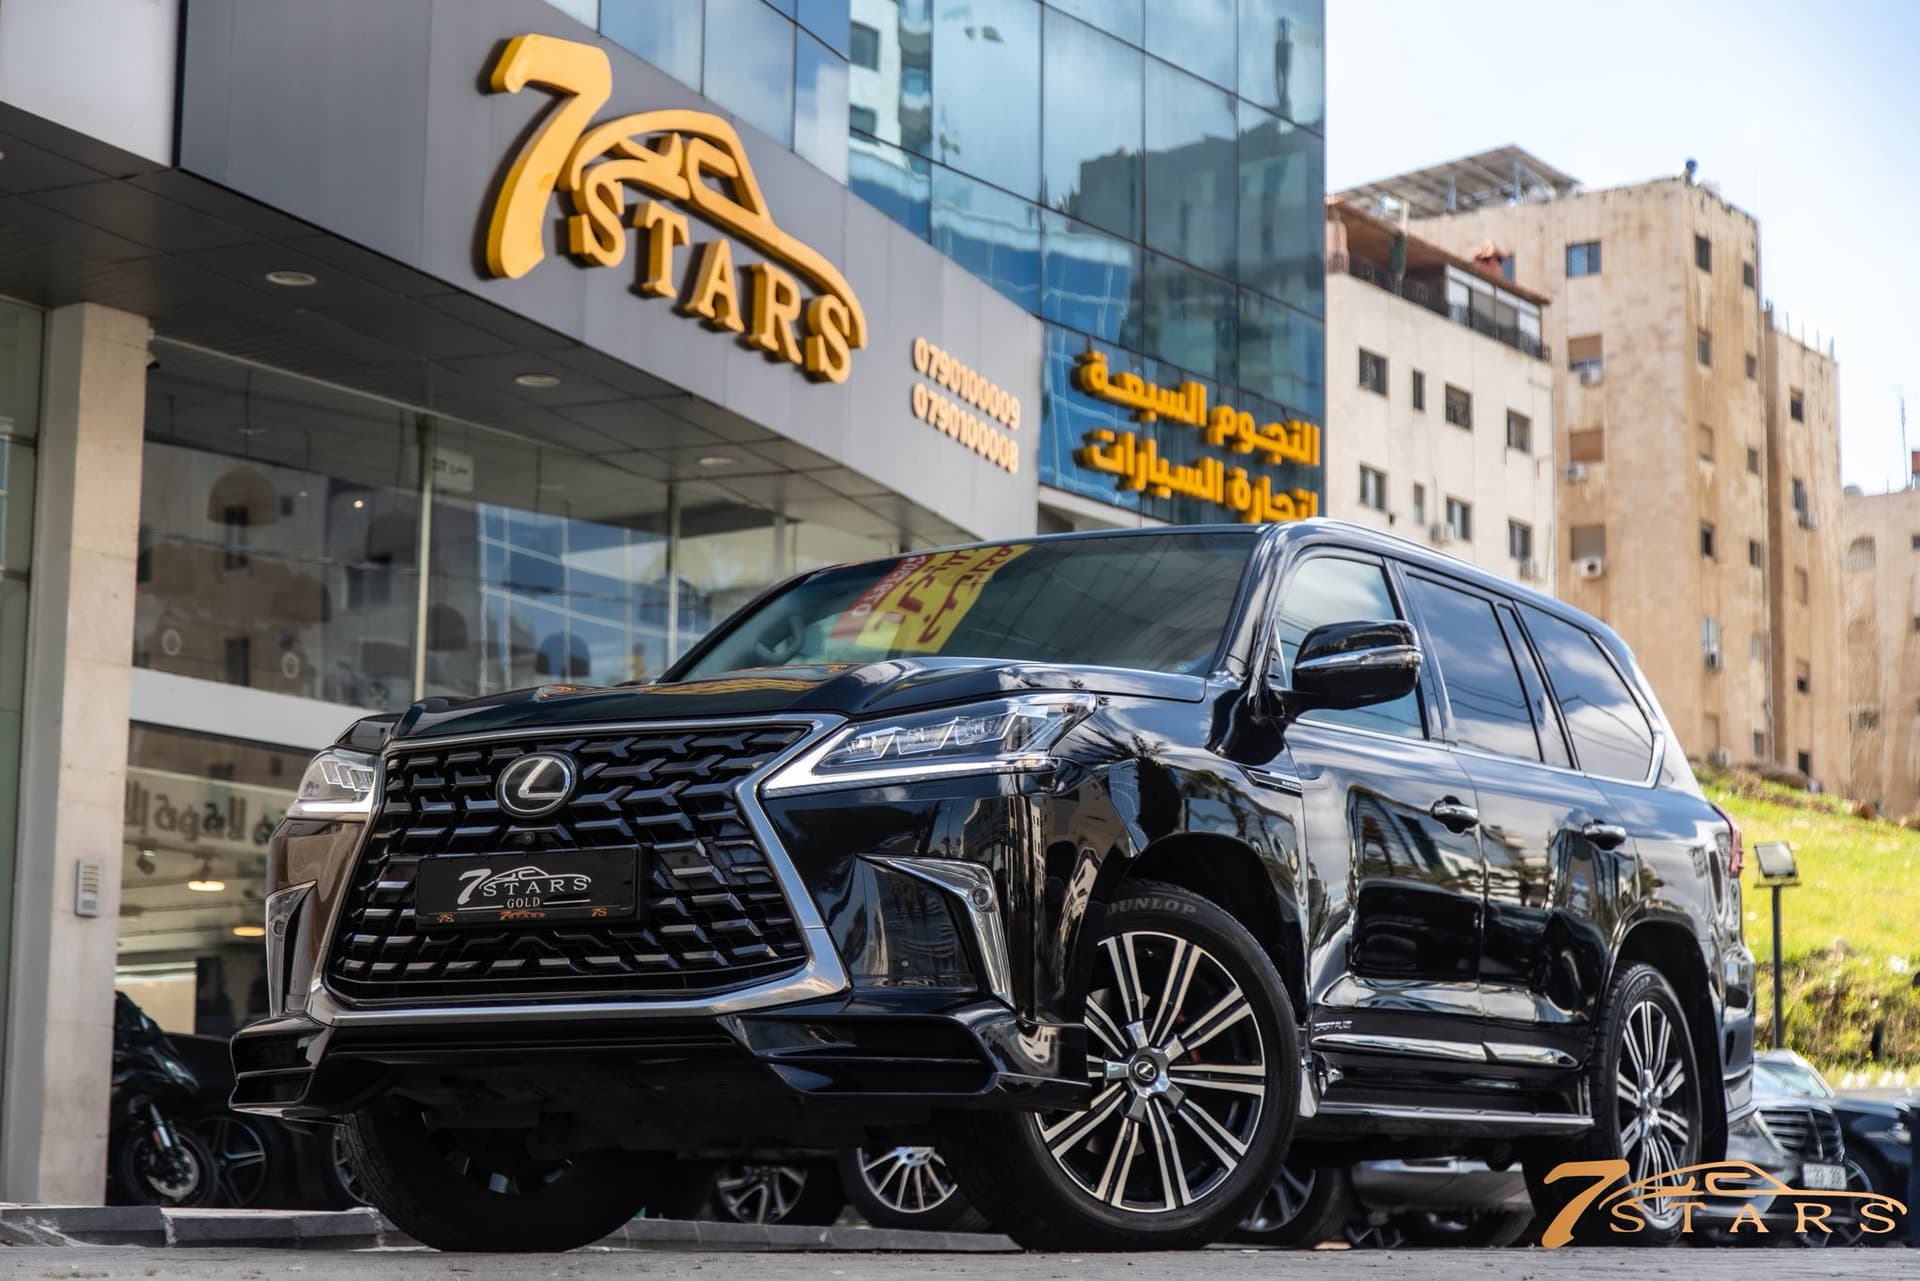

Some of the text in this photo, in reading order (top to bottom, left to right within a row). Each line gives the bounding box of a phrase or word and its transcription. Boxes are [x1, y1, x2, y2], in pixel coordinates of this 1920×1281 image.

[1079, 350, 1320, 467] النجوم السبعة
[1083, 429, 1225, 504] السيارات
[506, 897, 541, 909] GOLD
[1105, 897, 1197, 916] DUNLOP
